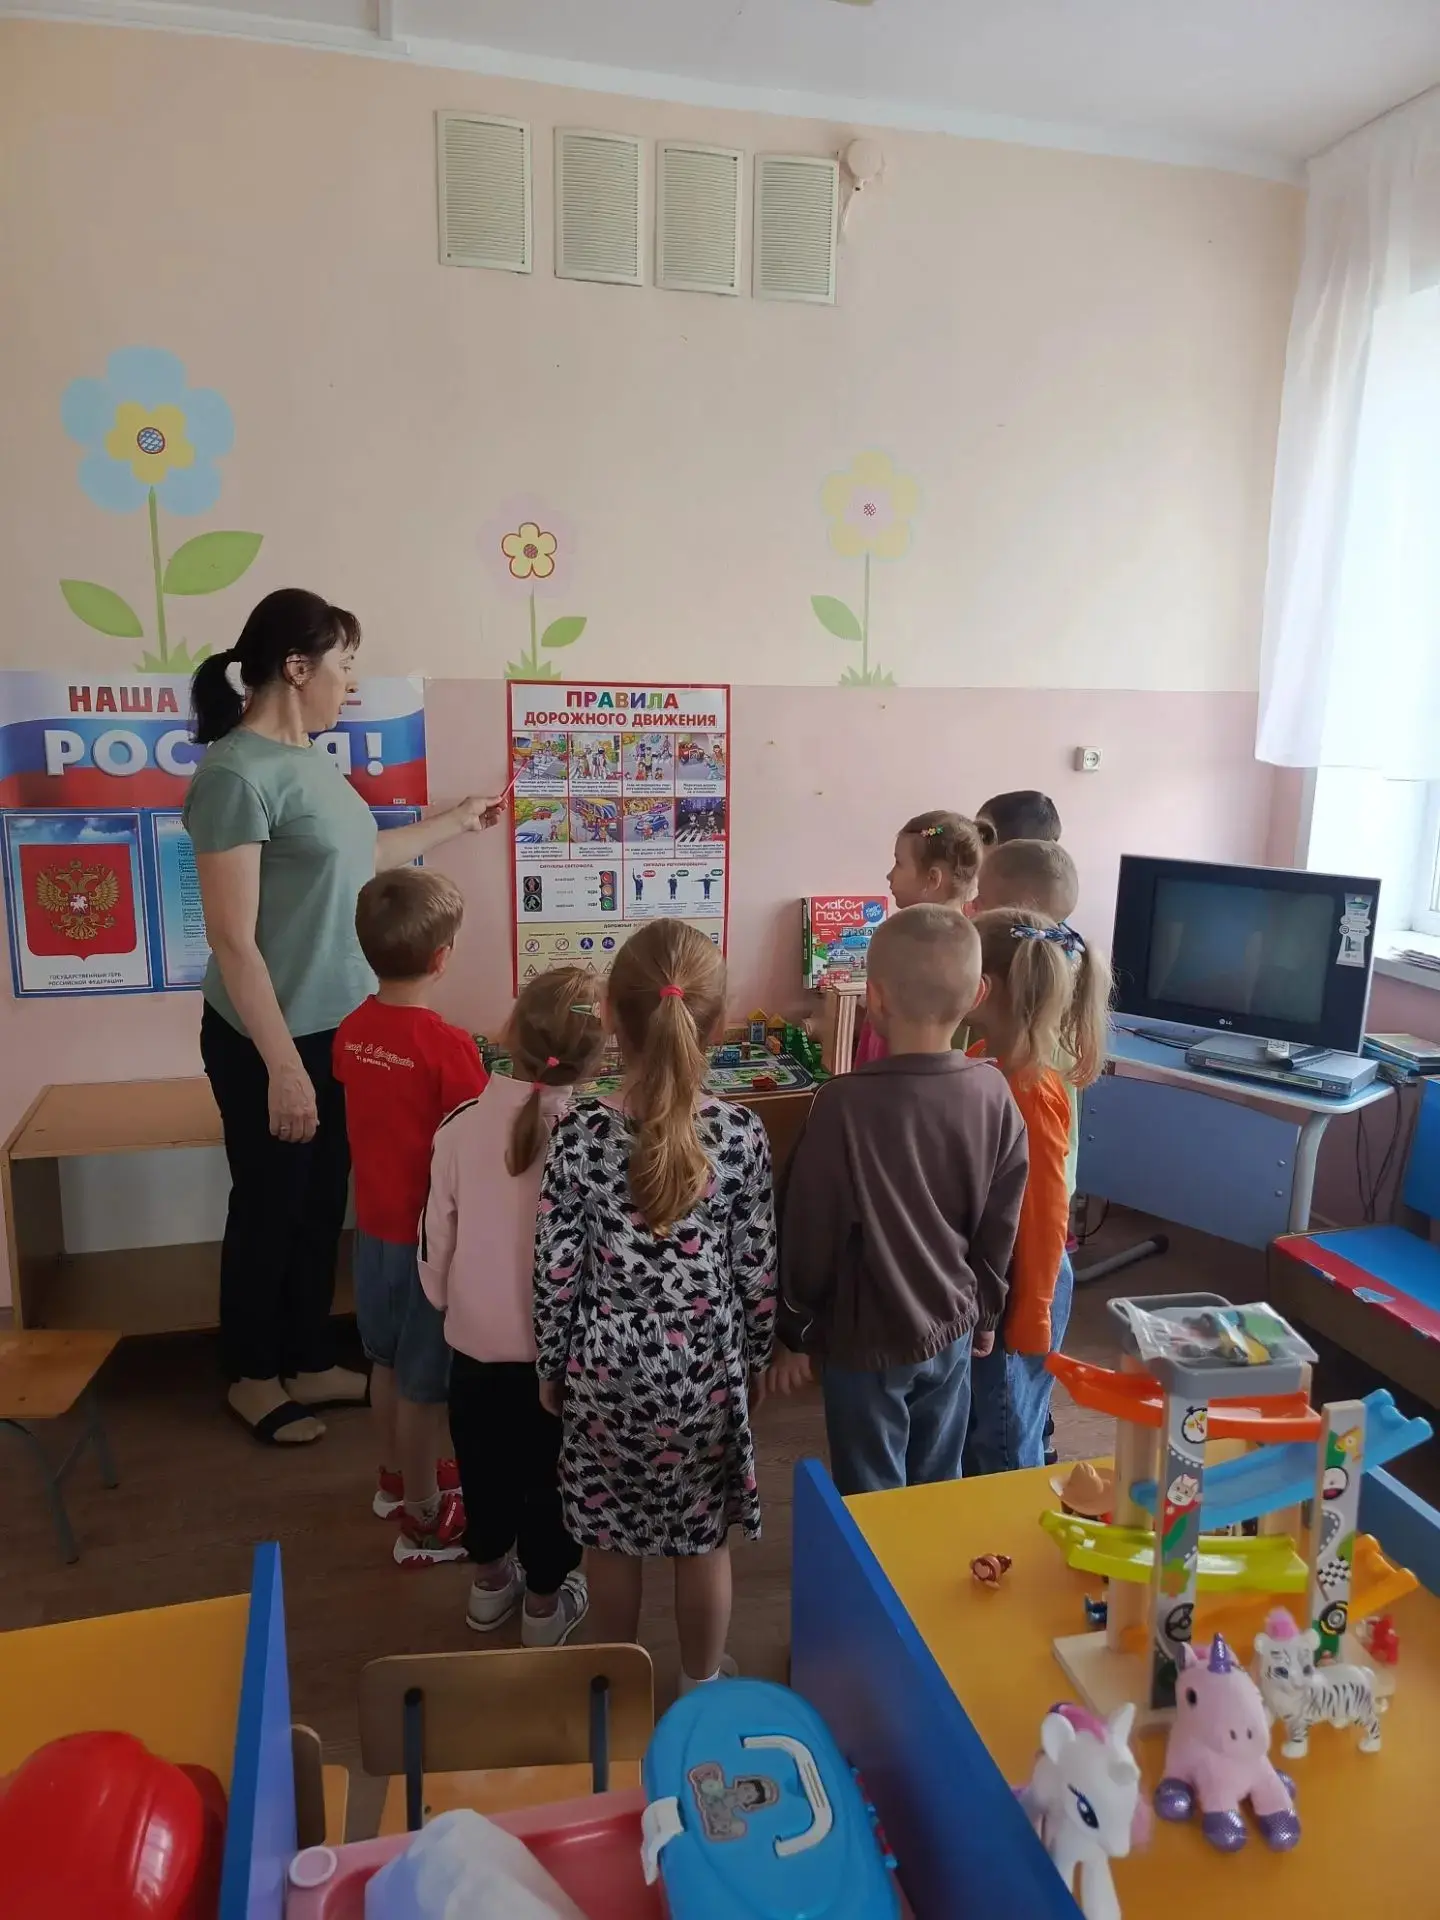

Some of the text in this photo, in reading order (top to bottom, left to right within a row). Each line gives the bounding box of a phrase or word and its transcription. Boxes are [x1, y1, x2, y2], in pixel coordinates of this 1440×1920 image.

[69, 686, 180, 713] НАША
[566, 691, 679, 709] ПРАВИЛА
[524, 711, 716, 727] ДОРОЖНОГО ДВИЖЕНИЯ
